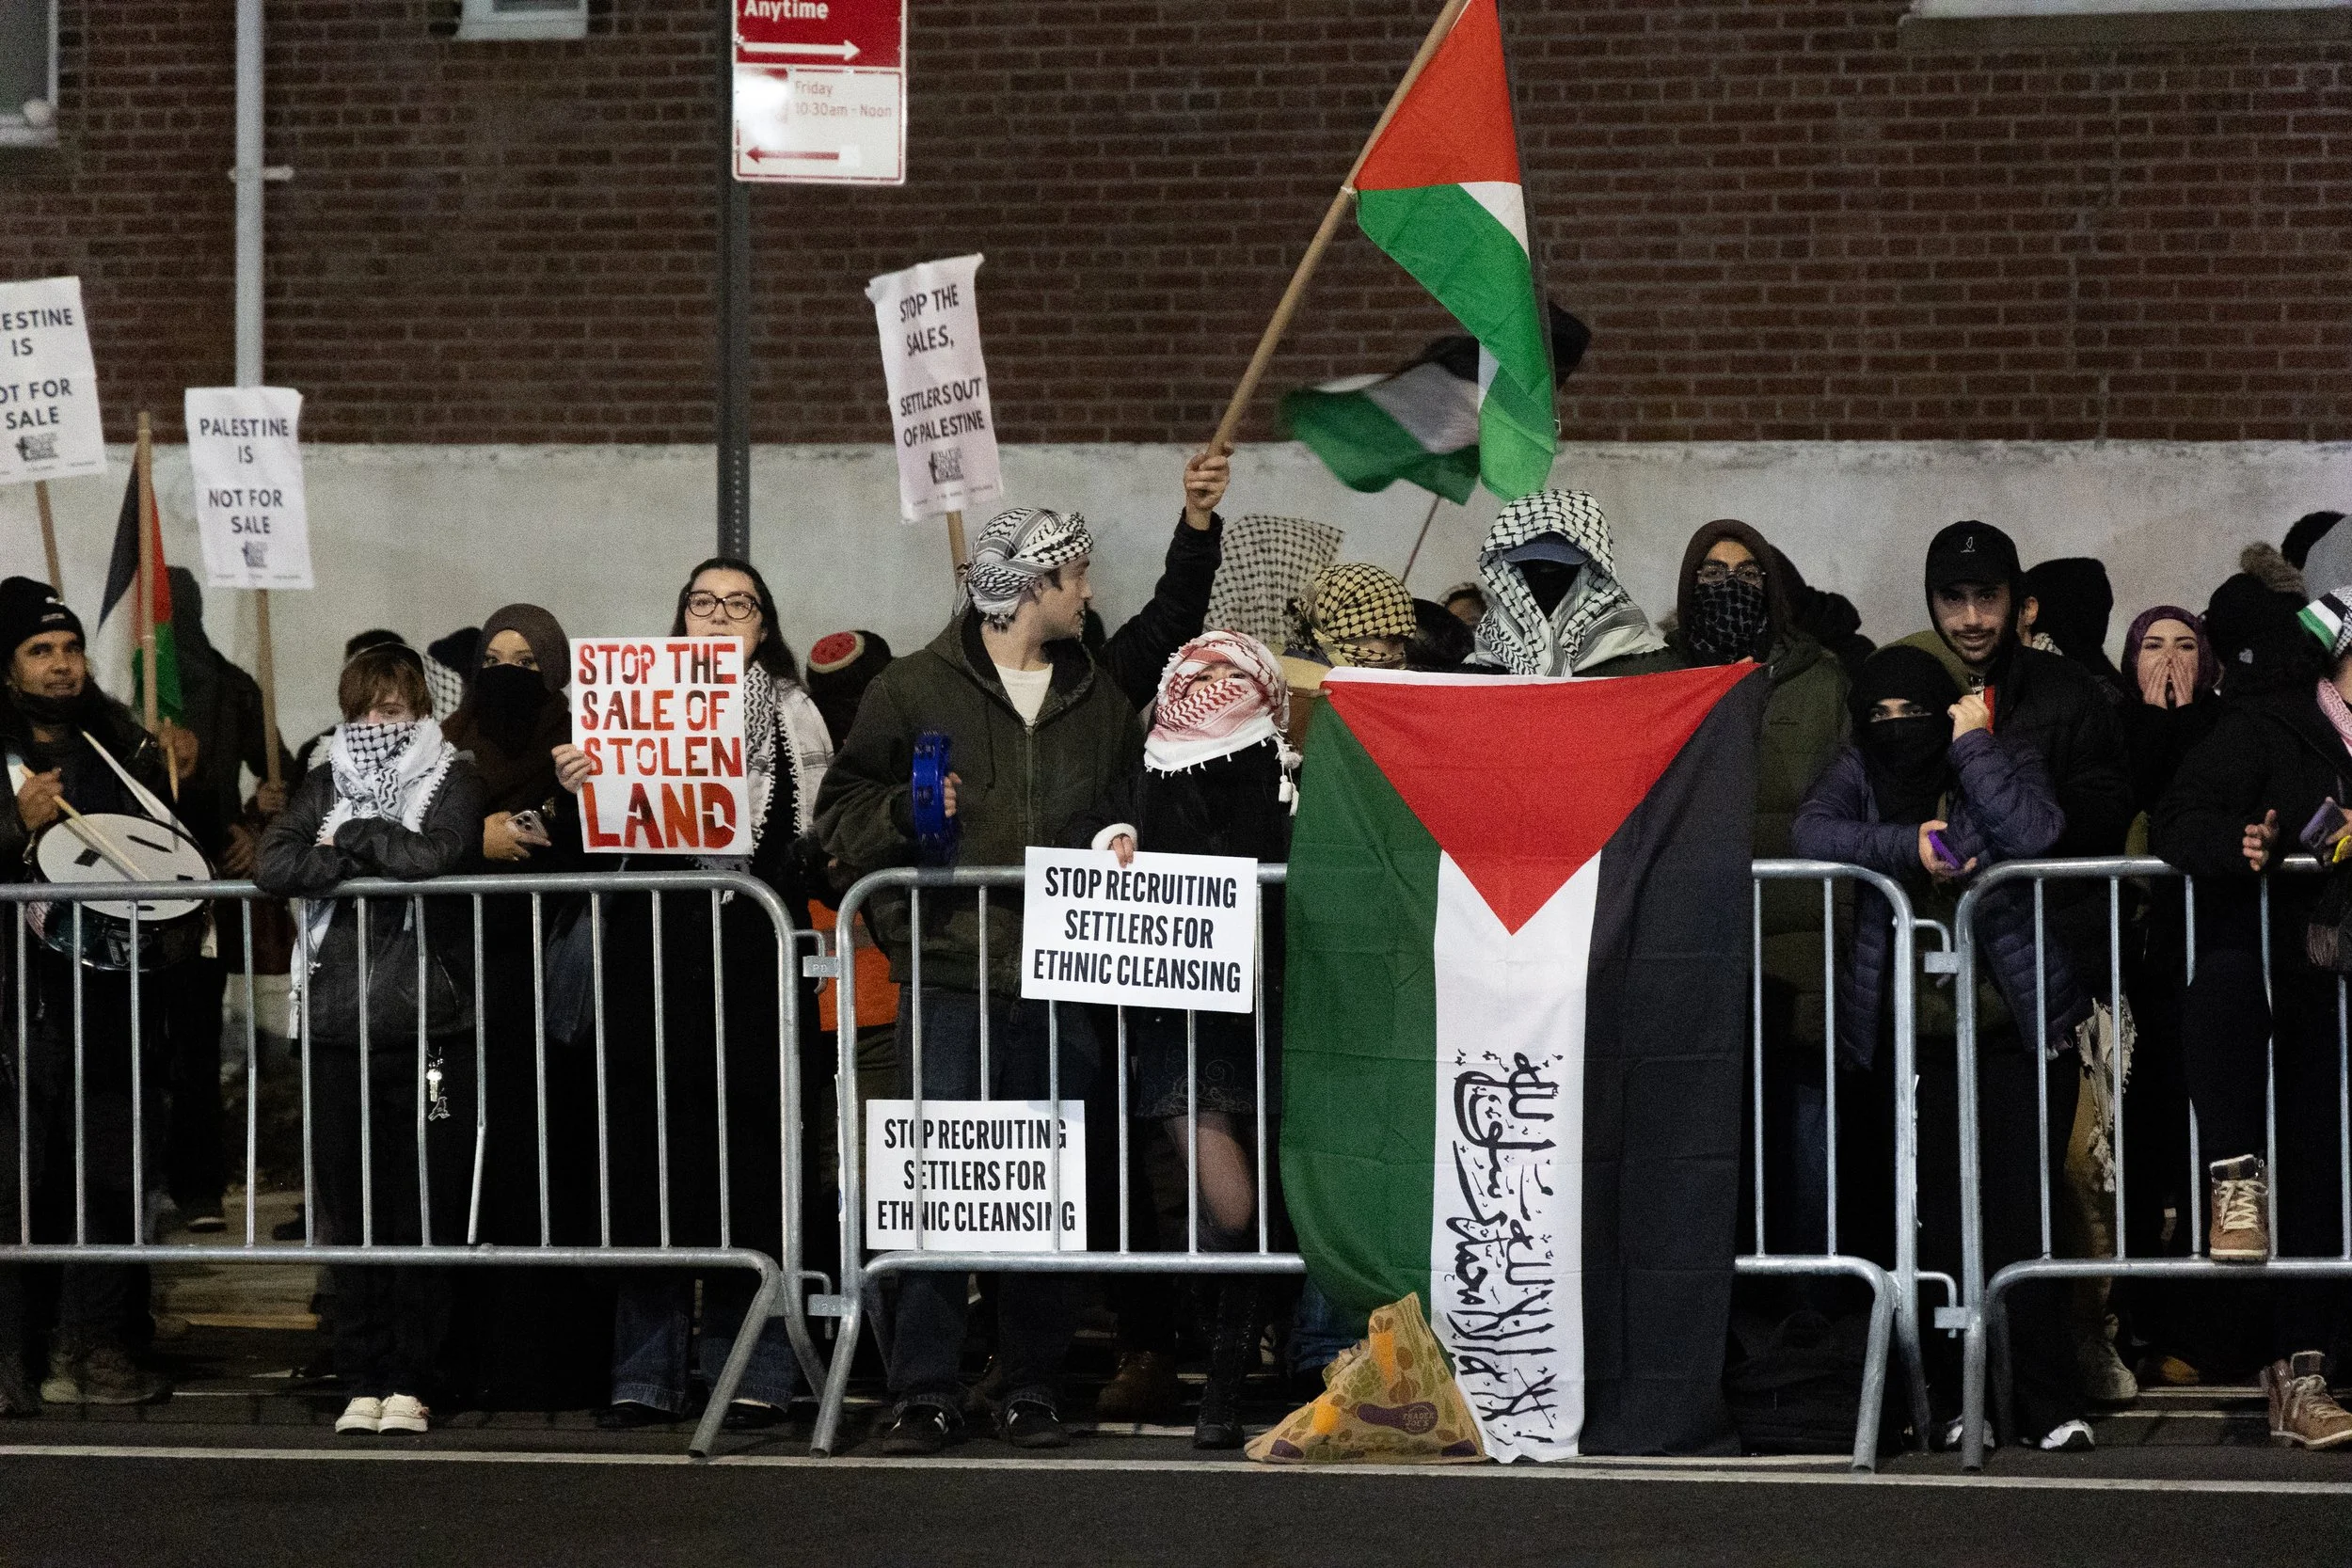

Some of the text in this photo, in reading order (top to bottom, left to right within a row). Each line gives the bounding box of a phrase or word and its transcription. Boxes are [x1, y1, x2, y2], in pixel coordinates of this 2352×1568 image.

[743, 0, 829, 23] Anytime
[795, 81, 834, 97] Friday
[860, 104, 892, 118] Noon
[899, 284, 959, 322] STOP THE
[0, 309, 73, 330] ESTINE
[11, 338, 33, 356] IS
[906, 325, 955, 356] SALES,
[0, 378, 72, 404] OT FOR
[900, 377, 981, 417] SETTLERS OUT
[6, 405, 59, 430] SALE
[199, 419, 289, 436] PALESTINE
[903, 410, 985, 448] OF PALESTINE
[238, 445, 254, 463] IS
[209, 489, 283, 507] NOT FOR
[231, 516, 271, 533] SALE
[578, 642, 737, 685] STOP THE
[580, 689, 730, 731] SALE OF
[583, 736, 743, 777] STOLEN
[581, 782, 737, 849] LAND
[1044, 865, 1237, 909] STOP RECRUITING
[1064, 909, 1214, 949] SETTLERS FOR
[1033, 948, 1242, 993] ETHNIC CLEANSING
[1006, 1160, 1046, 1191] FOR
